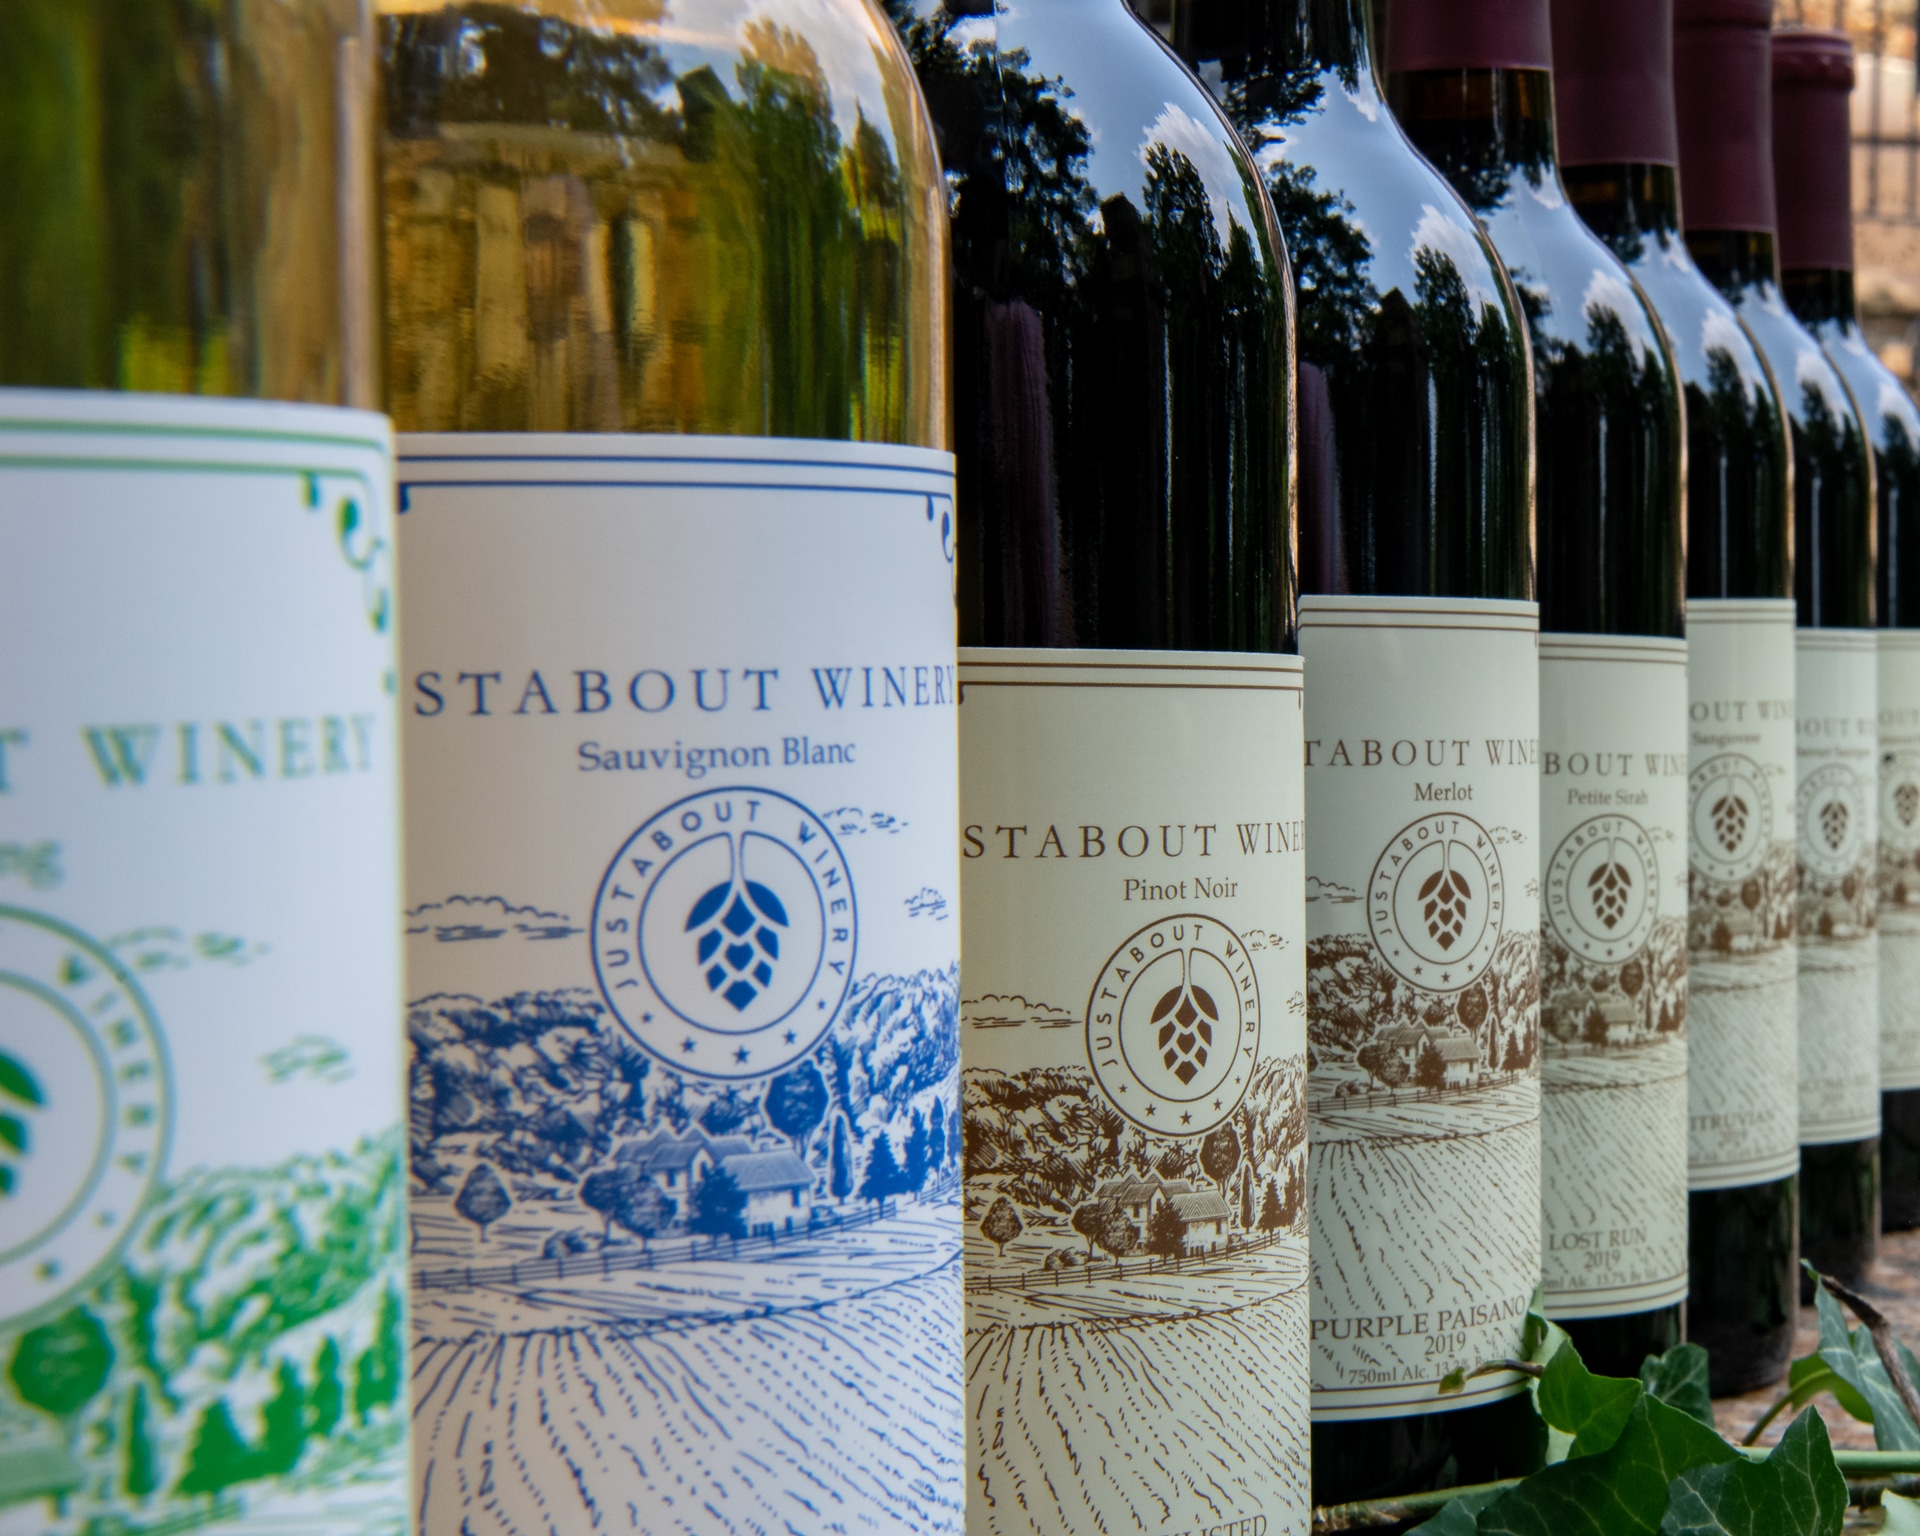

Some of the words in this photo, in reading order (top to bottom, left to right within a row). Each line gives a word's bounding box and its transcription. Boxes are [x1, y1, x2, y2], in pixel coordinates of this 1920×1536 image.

[413, 668, 779, 716] STABOUT
[82, 713, 374, 787] WINERY
[578, 739, 770, 778] Sauvignon
[782, 736, 857, 767] Blanc
[1543, 752, 1633, 776] BOUT
[1414, 782, 1473, 802] Merlot
[1567, 788, 1612, 806] Petite
[1615, 788, 1649, 806] Sirah
[962, 824, 1217, 858] STABOUT
[606, 801, 762, 989] JUSTABOUT
[797, 821, 849, 976] WINERY
[1123, 878, 1188, 901] Pinot
[1194, 876, 1239, 900] Noir
[1375, 821, 1460, 936] JUSTABOUT
[1096, 924, 1204, 1067] JUSTABOUT
[1225, 940, 1256, 1058] WINERY
[1548, 1231, 1603, 1251] LOST
[1609, 1228, 1647, 1247] RUN
[1310, 1312, 1429, 1341] PURPLE
[1437, 1295, 1526, 1332] PAISANO
[1424, 1331, 1466, 1356] 2019
[1350, 1367, 1397, 1384] 750ml
[1402, 1364, 1430, 1381] Alc.
